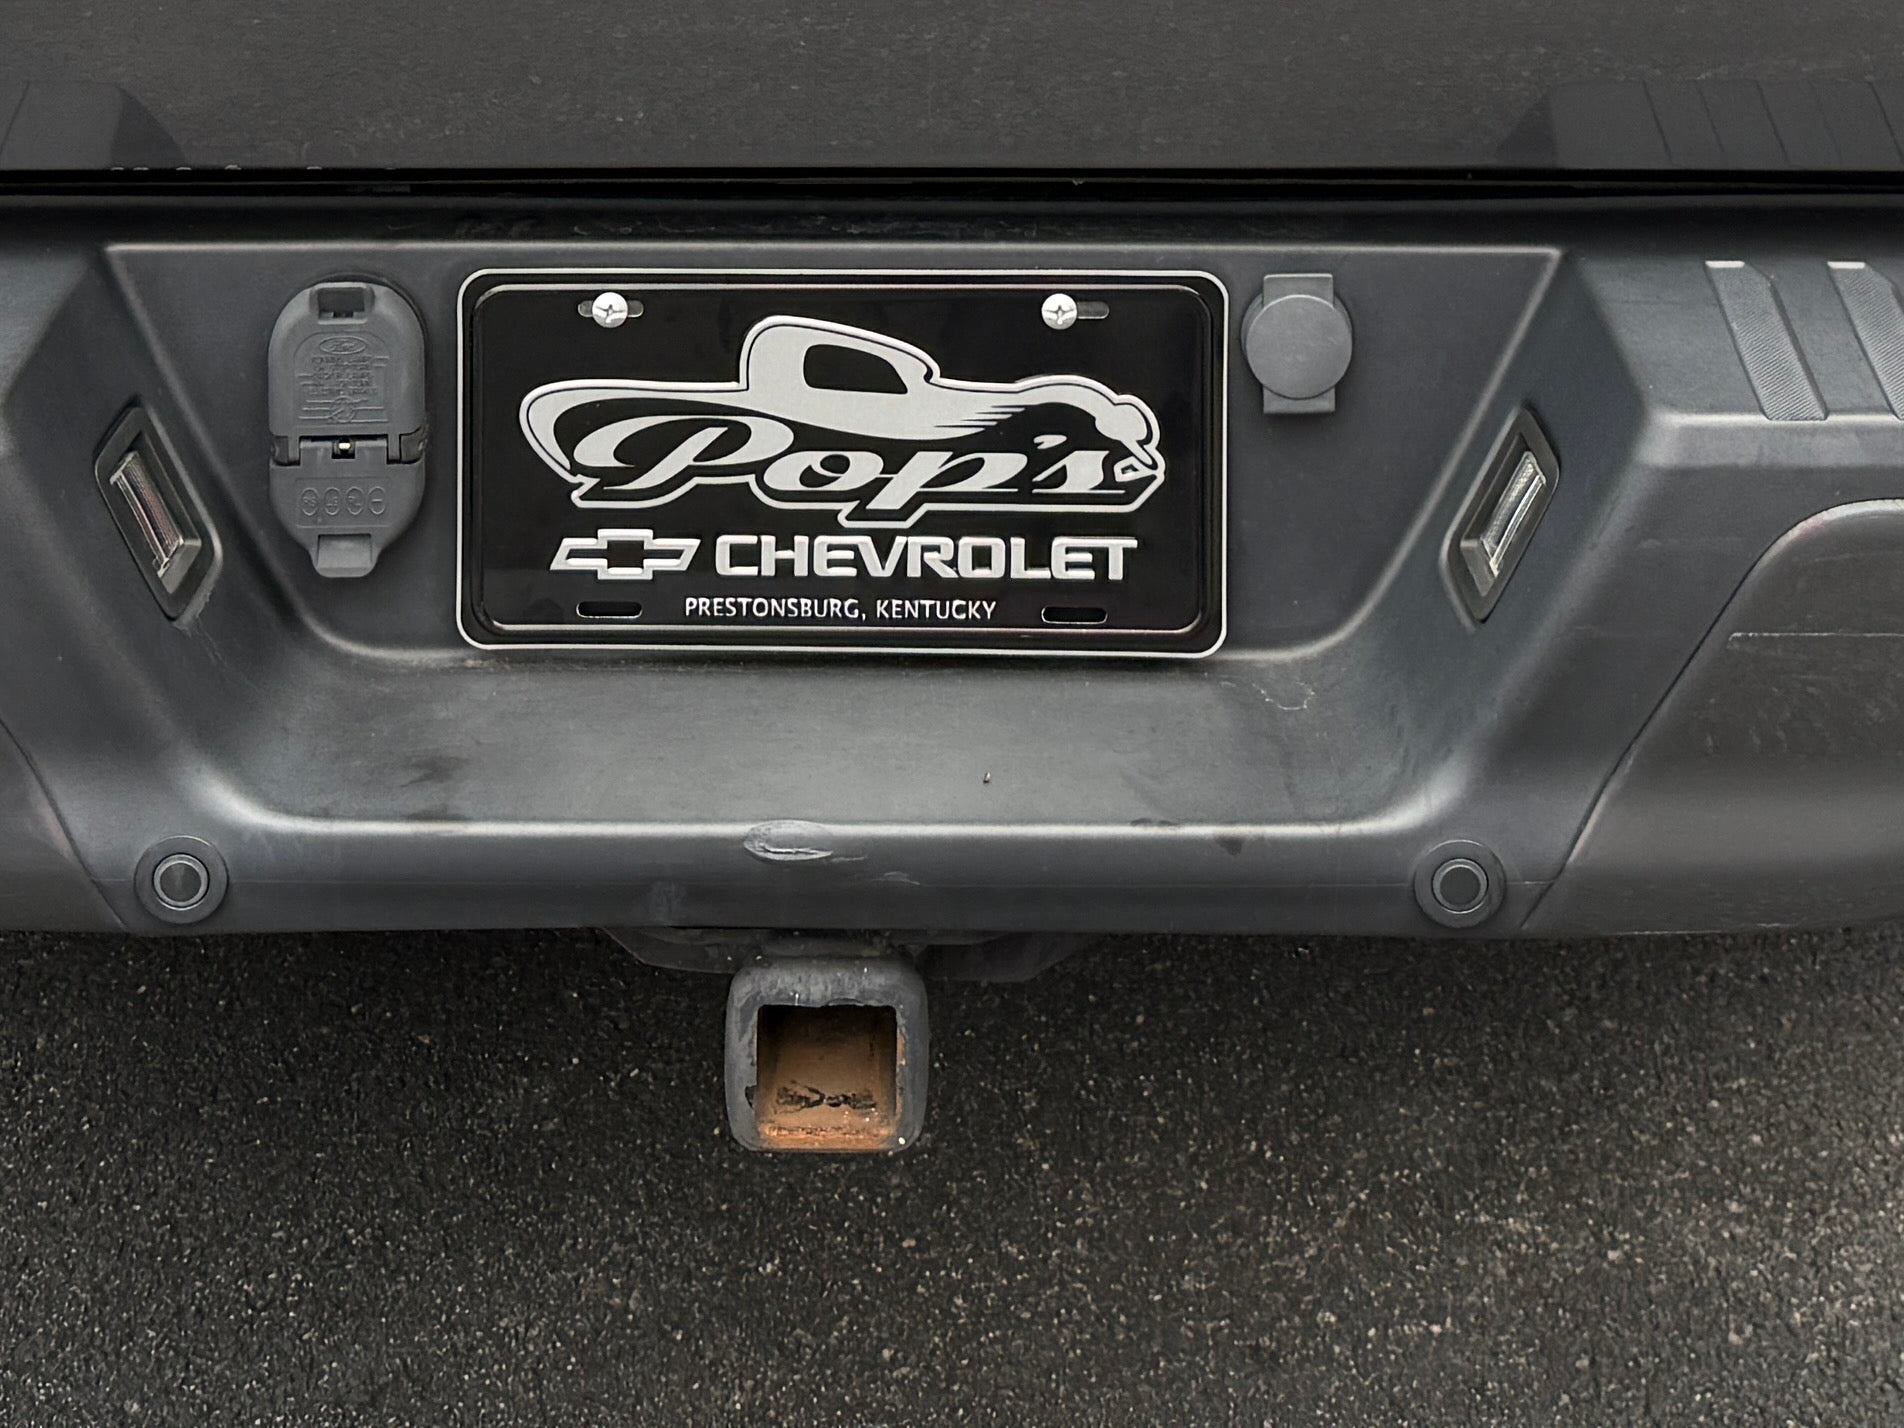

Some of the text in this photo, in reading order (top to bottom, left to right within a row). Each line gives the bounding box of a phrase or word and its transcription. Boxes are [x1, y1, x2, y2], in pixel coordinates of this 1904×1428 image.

[714, 533, 1140, 582] CHEVROLET
[684, 596, 998, 622] PRESTONSBURG, KENTUCKY
